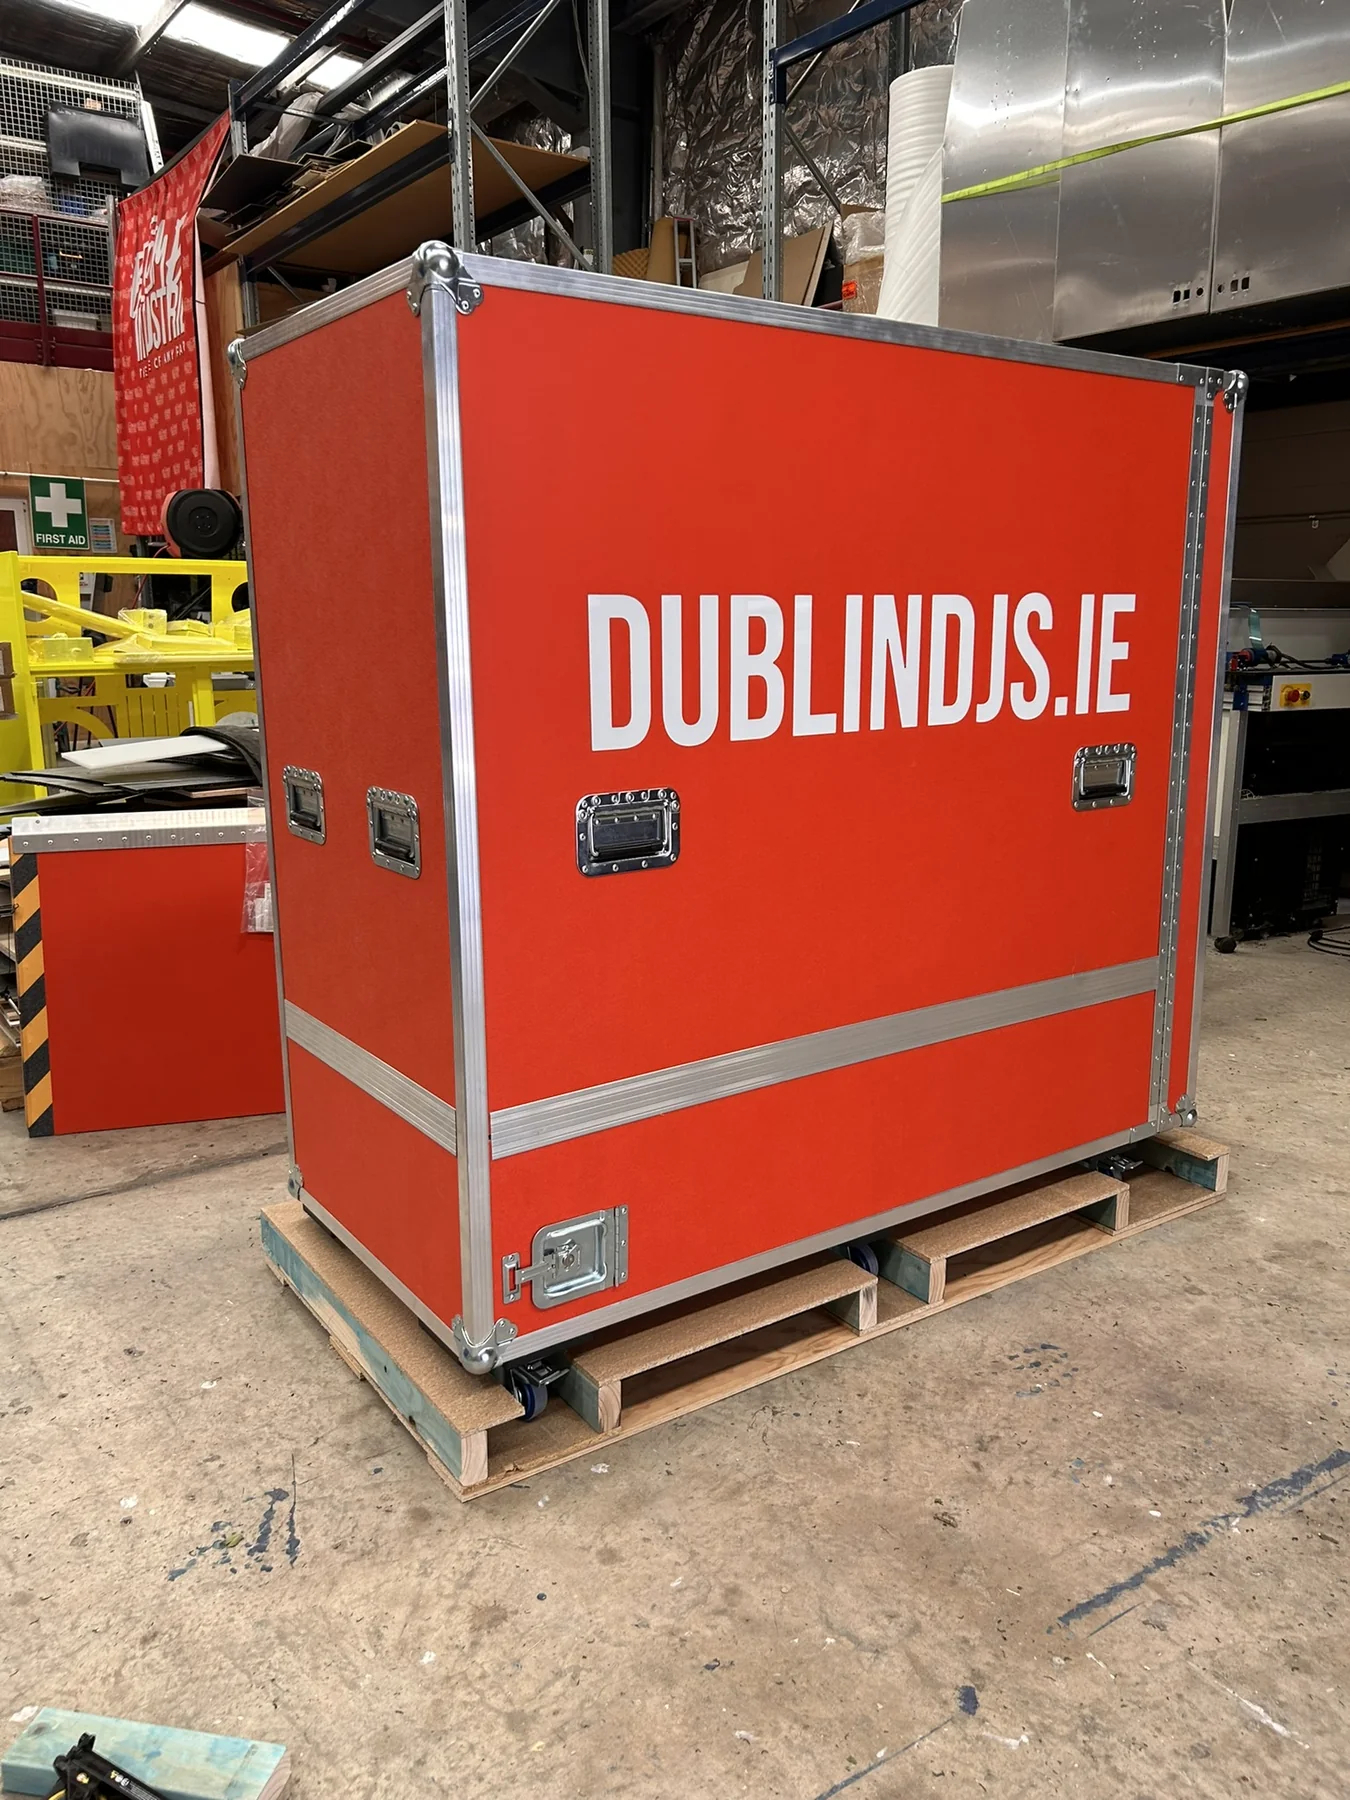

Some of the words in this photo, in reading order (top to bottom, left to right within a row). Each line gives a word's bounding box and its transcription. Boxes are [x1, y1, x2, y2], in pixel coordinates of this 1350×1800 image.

[35, 533, 66, 544] FIRST
[68, 535, 86, 545] AID
[587, 592, 1136, 751] DUBLINDJS.IE
